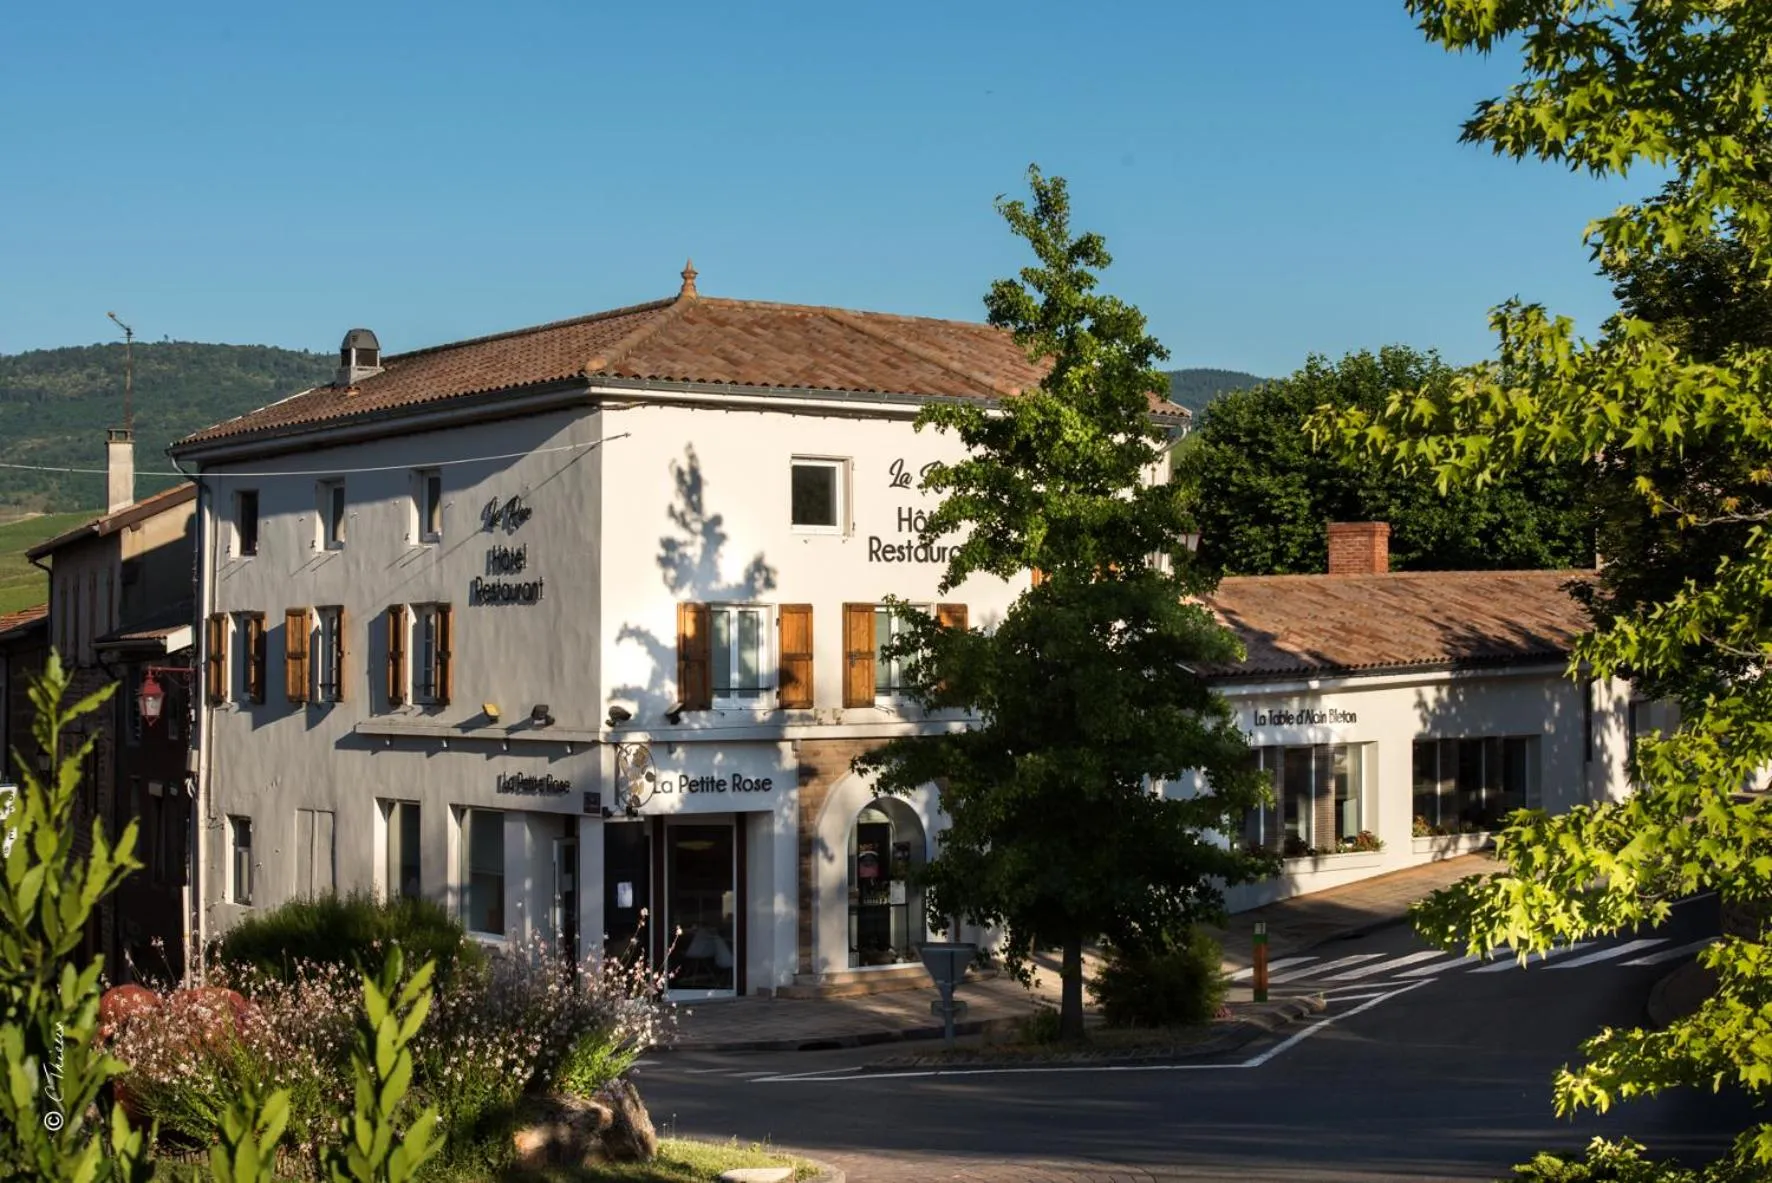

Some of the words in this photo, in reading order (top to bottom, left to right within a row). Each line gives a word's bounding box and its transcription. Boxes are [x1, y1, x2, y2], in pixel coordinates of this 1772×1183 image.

[888, 458, 913, 489] La
[868, 535, 963, 562] Restaur
[1254, 709, 1267, 727] La
[1268, 708, 1294, 727] Table
[1328, 707, 1357, 724] Bleton
[652, 775, 673, 794] La
[678, 774, 728, 794] Petite
[731, 772, 773, 793] Rose
